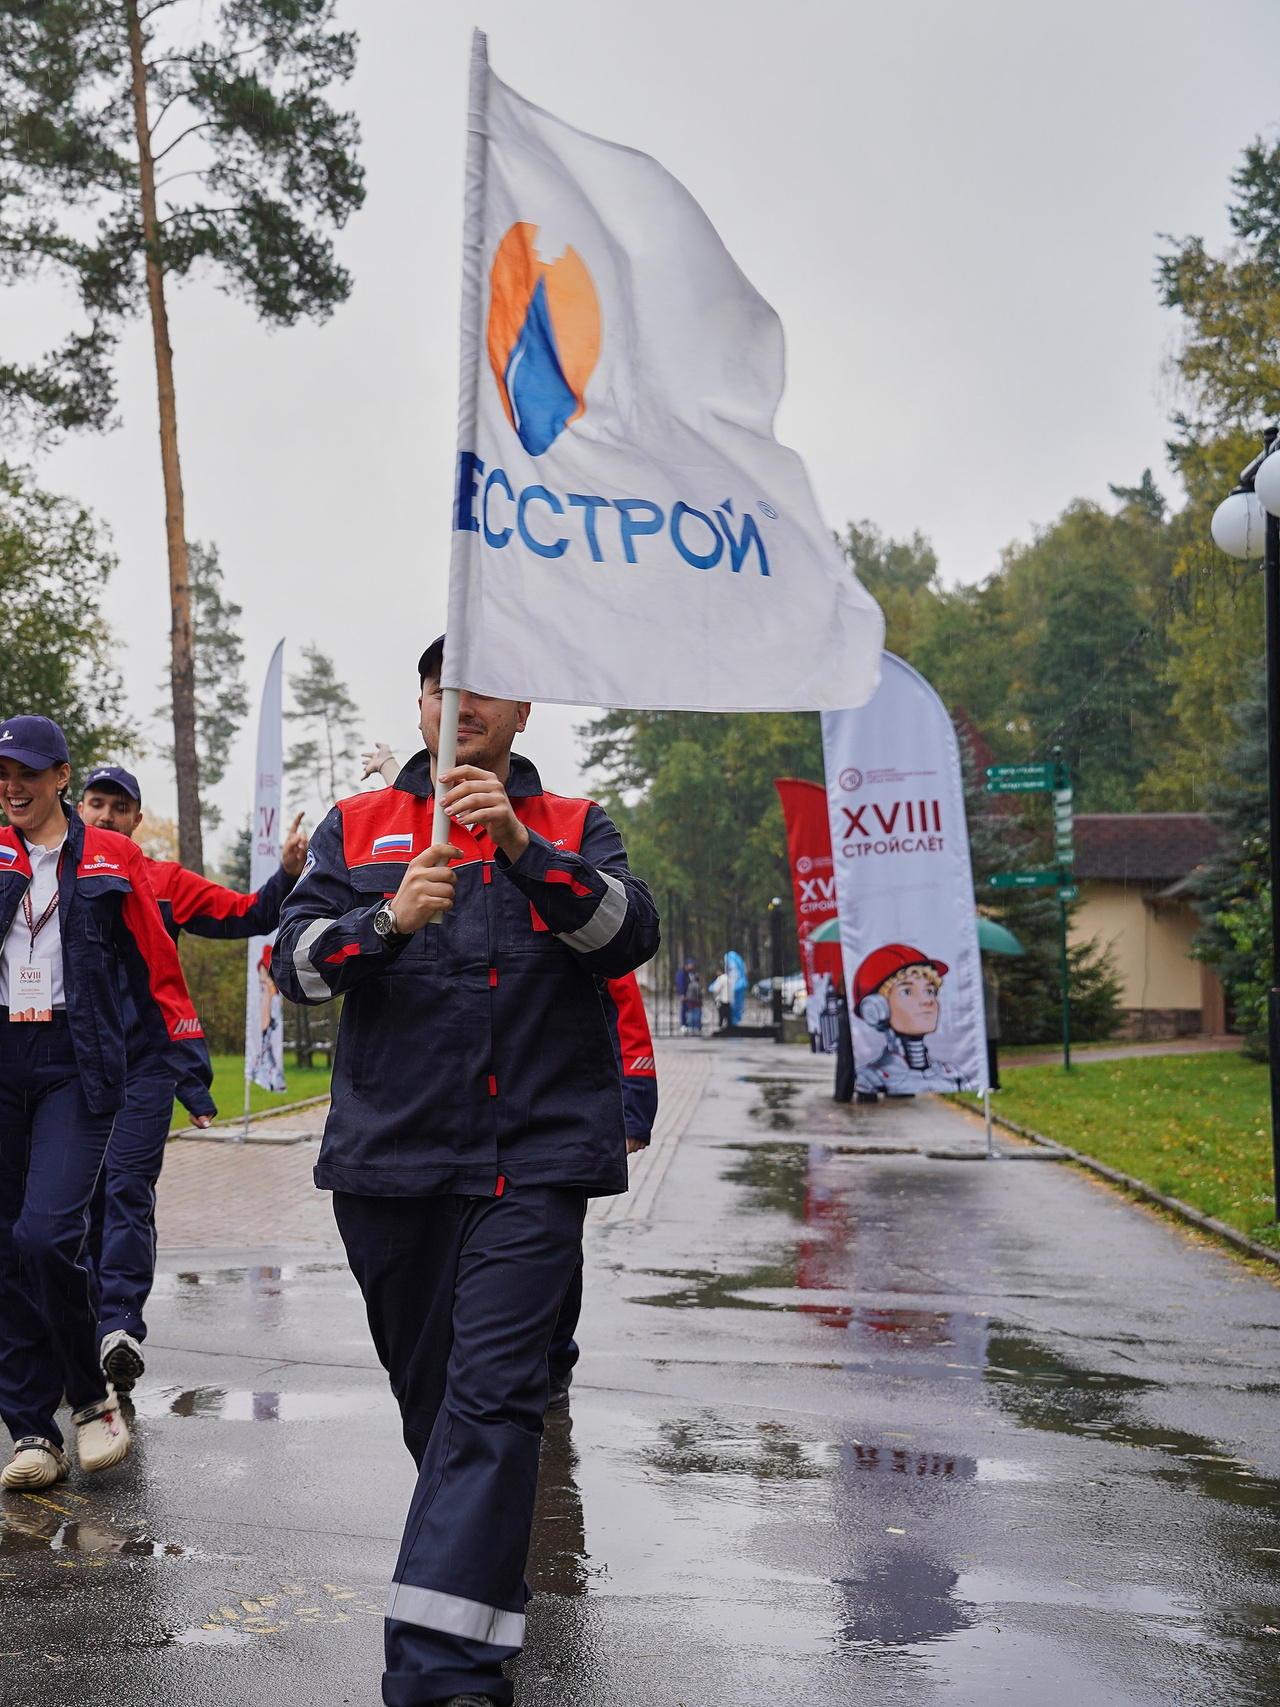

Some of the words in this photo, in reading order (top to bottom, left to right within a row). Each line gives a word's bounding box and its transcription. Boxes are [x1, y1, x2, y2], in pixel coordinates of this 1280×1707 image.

[841, 800, 941, 839] XVIII
[842, 836, 944, 858] СТРОЙСЛЁТ
[20, 971, 41, 979] XVIII
